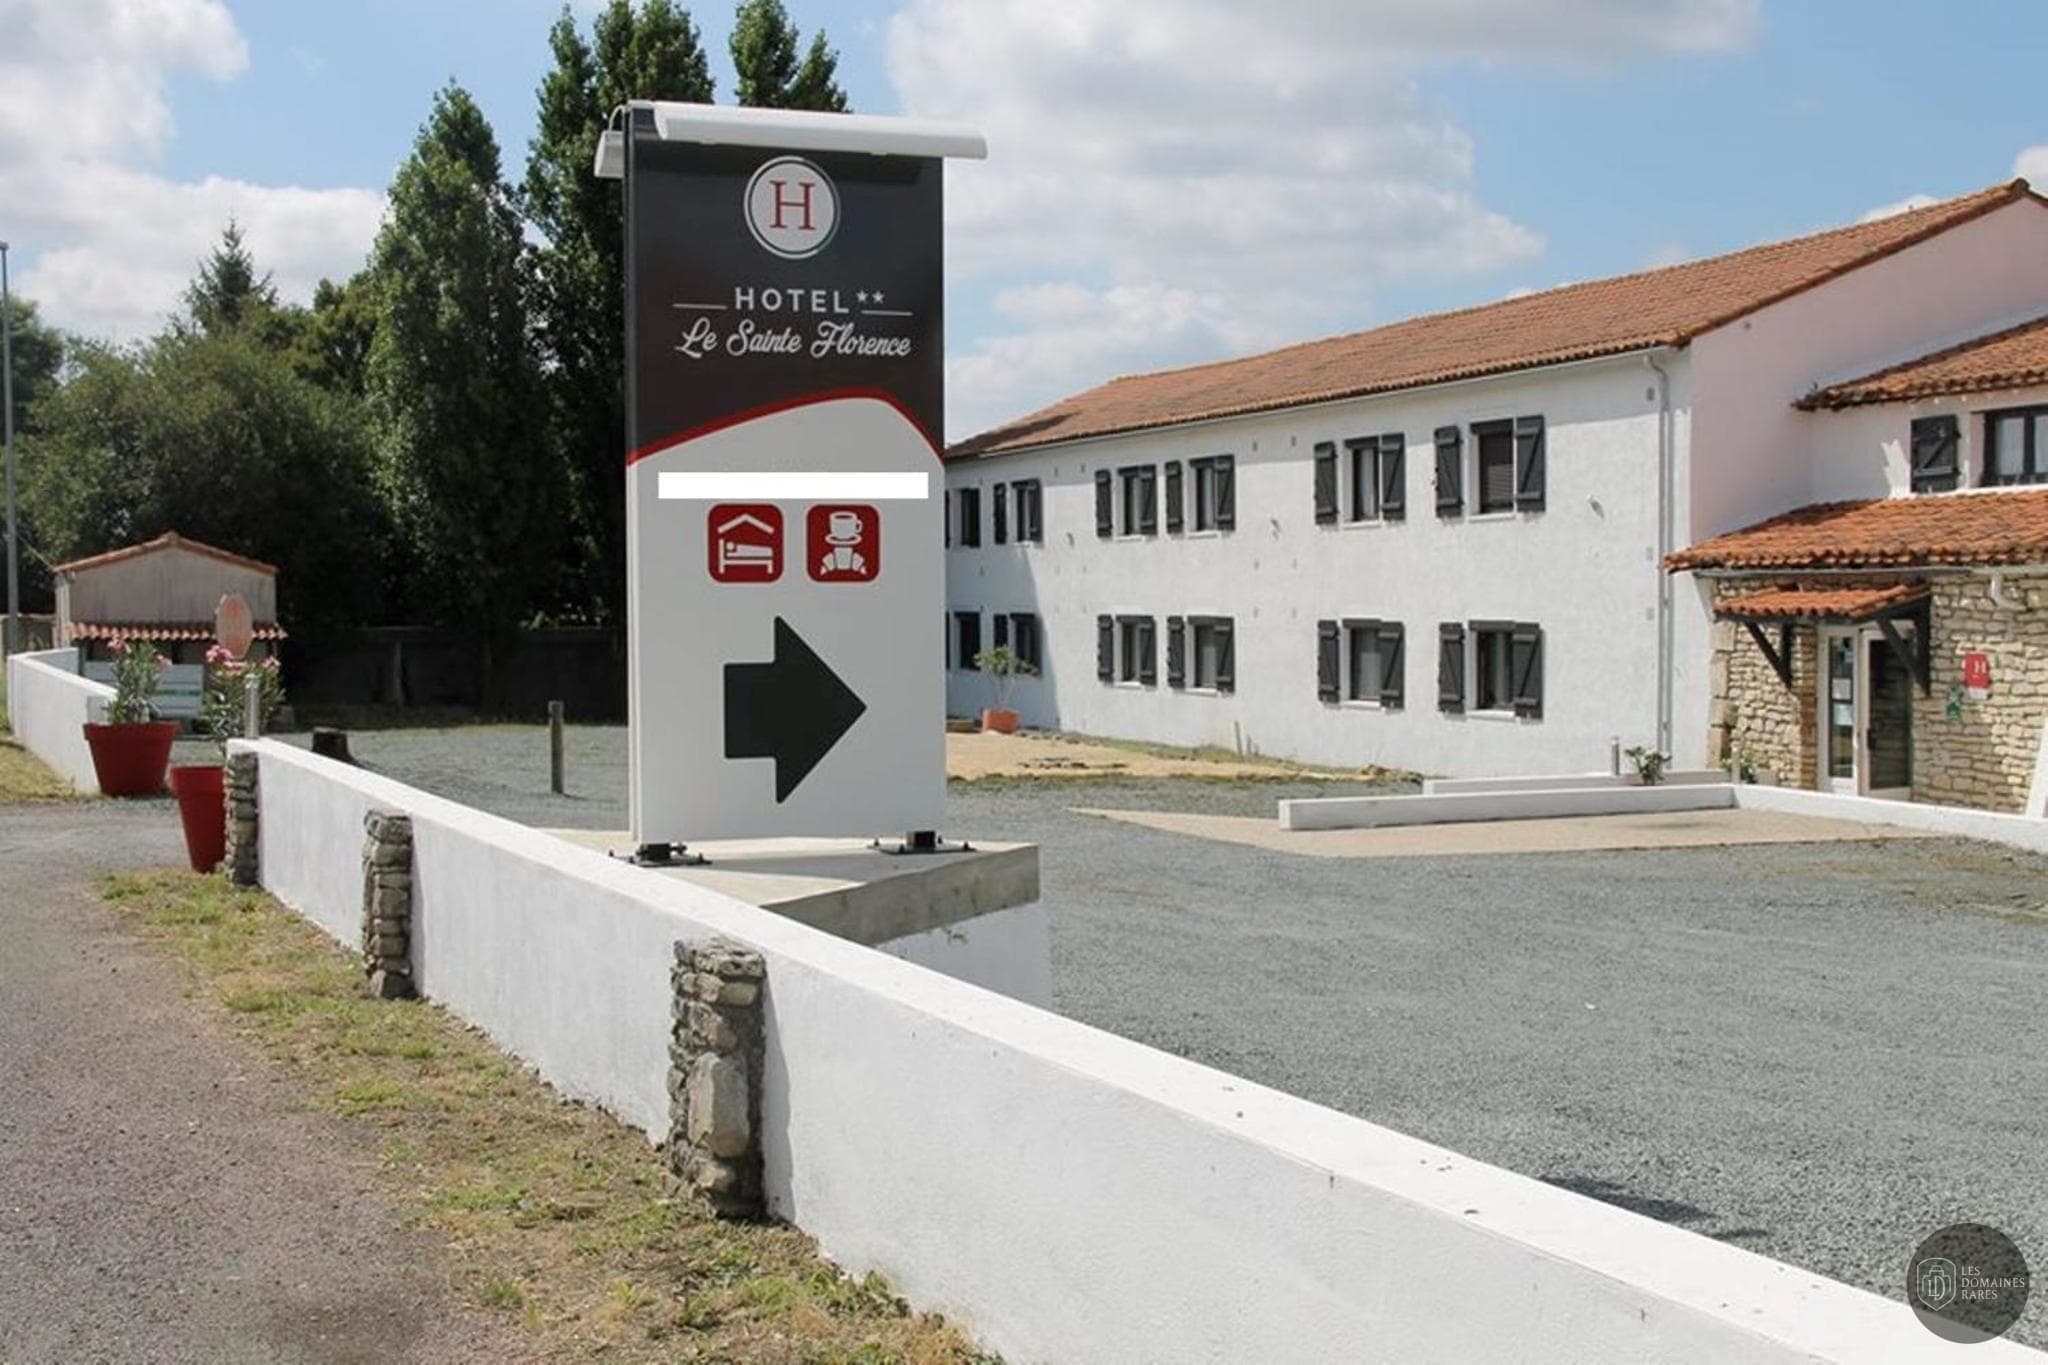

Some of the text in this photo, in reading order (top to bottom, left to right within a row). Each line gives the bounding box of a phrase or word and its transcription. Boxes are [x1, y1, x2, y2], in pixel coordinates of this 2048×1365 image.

[769, 180, 816, 230] H
[734, 286, 850, 314] HOTEL
[675, 317, 911, 358] Le Sainte Florence
